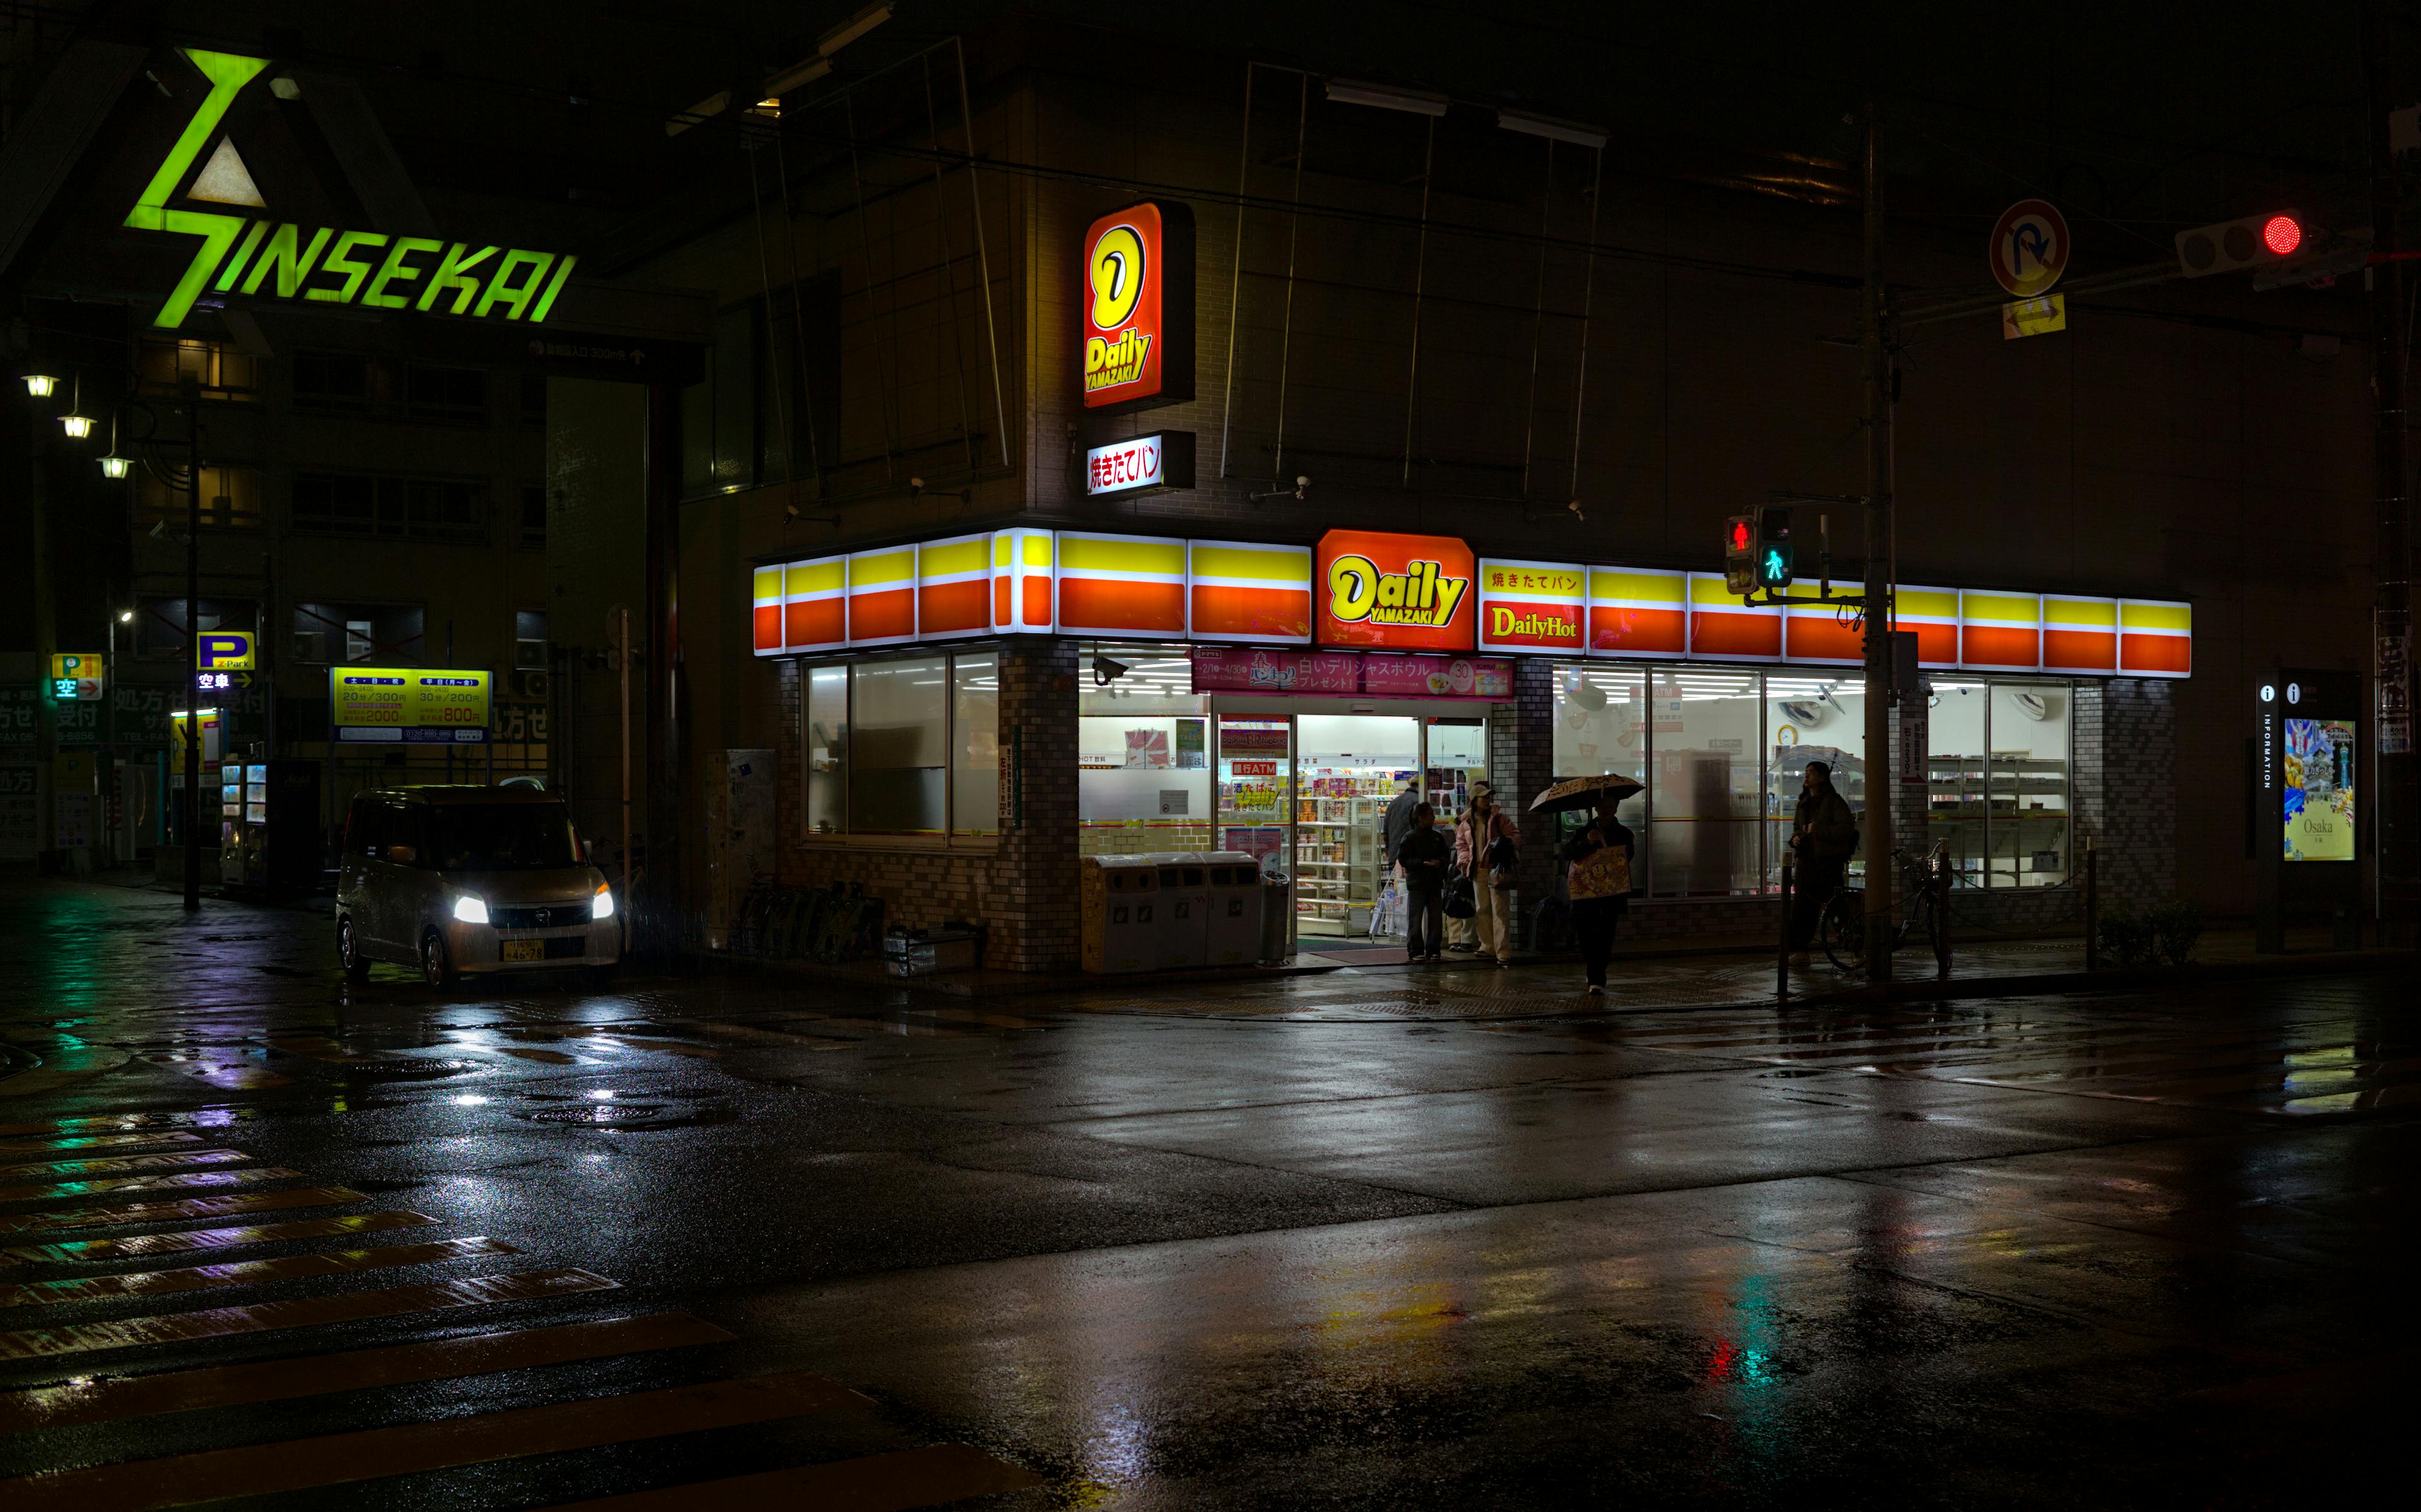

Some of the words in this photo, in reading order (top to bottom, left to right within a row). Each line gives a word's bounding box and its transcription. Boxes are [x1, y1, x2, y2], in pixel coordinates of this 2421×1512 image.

[1086, 330, 1151, 381] Daily
[1086, 371, 1134, 391] YAMAZAKI
[1090, 445, 1160, 489] 焼きたてパン
[1329, 555, 1468, 626] Daily
[1492, 572, 1577, 591] 焼きたてパン
[1371, 607, 1434, 625] YAMAZAKI
[1492, 606, 1577, 640] DailyHot
[199, 636, 248, 667] P
[1251, 652, 1272, 669] 春
[63, 655, 81, 676] P
[1250, 667, 1295, 681] パンまつり
[1299, 657, 1431, 678] 白いデリシャスボウル
[1455, 663, 1468, 678] 30
[55, 678, 77, 698] 空
[199, 673, 229, 690] 空車
[1233, 763, 1275, 775] 銀行ATM
[1234, 783, 1243, 794] 酒
[2304, 819, 2333, 833] Osaka
